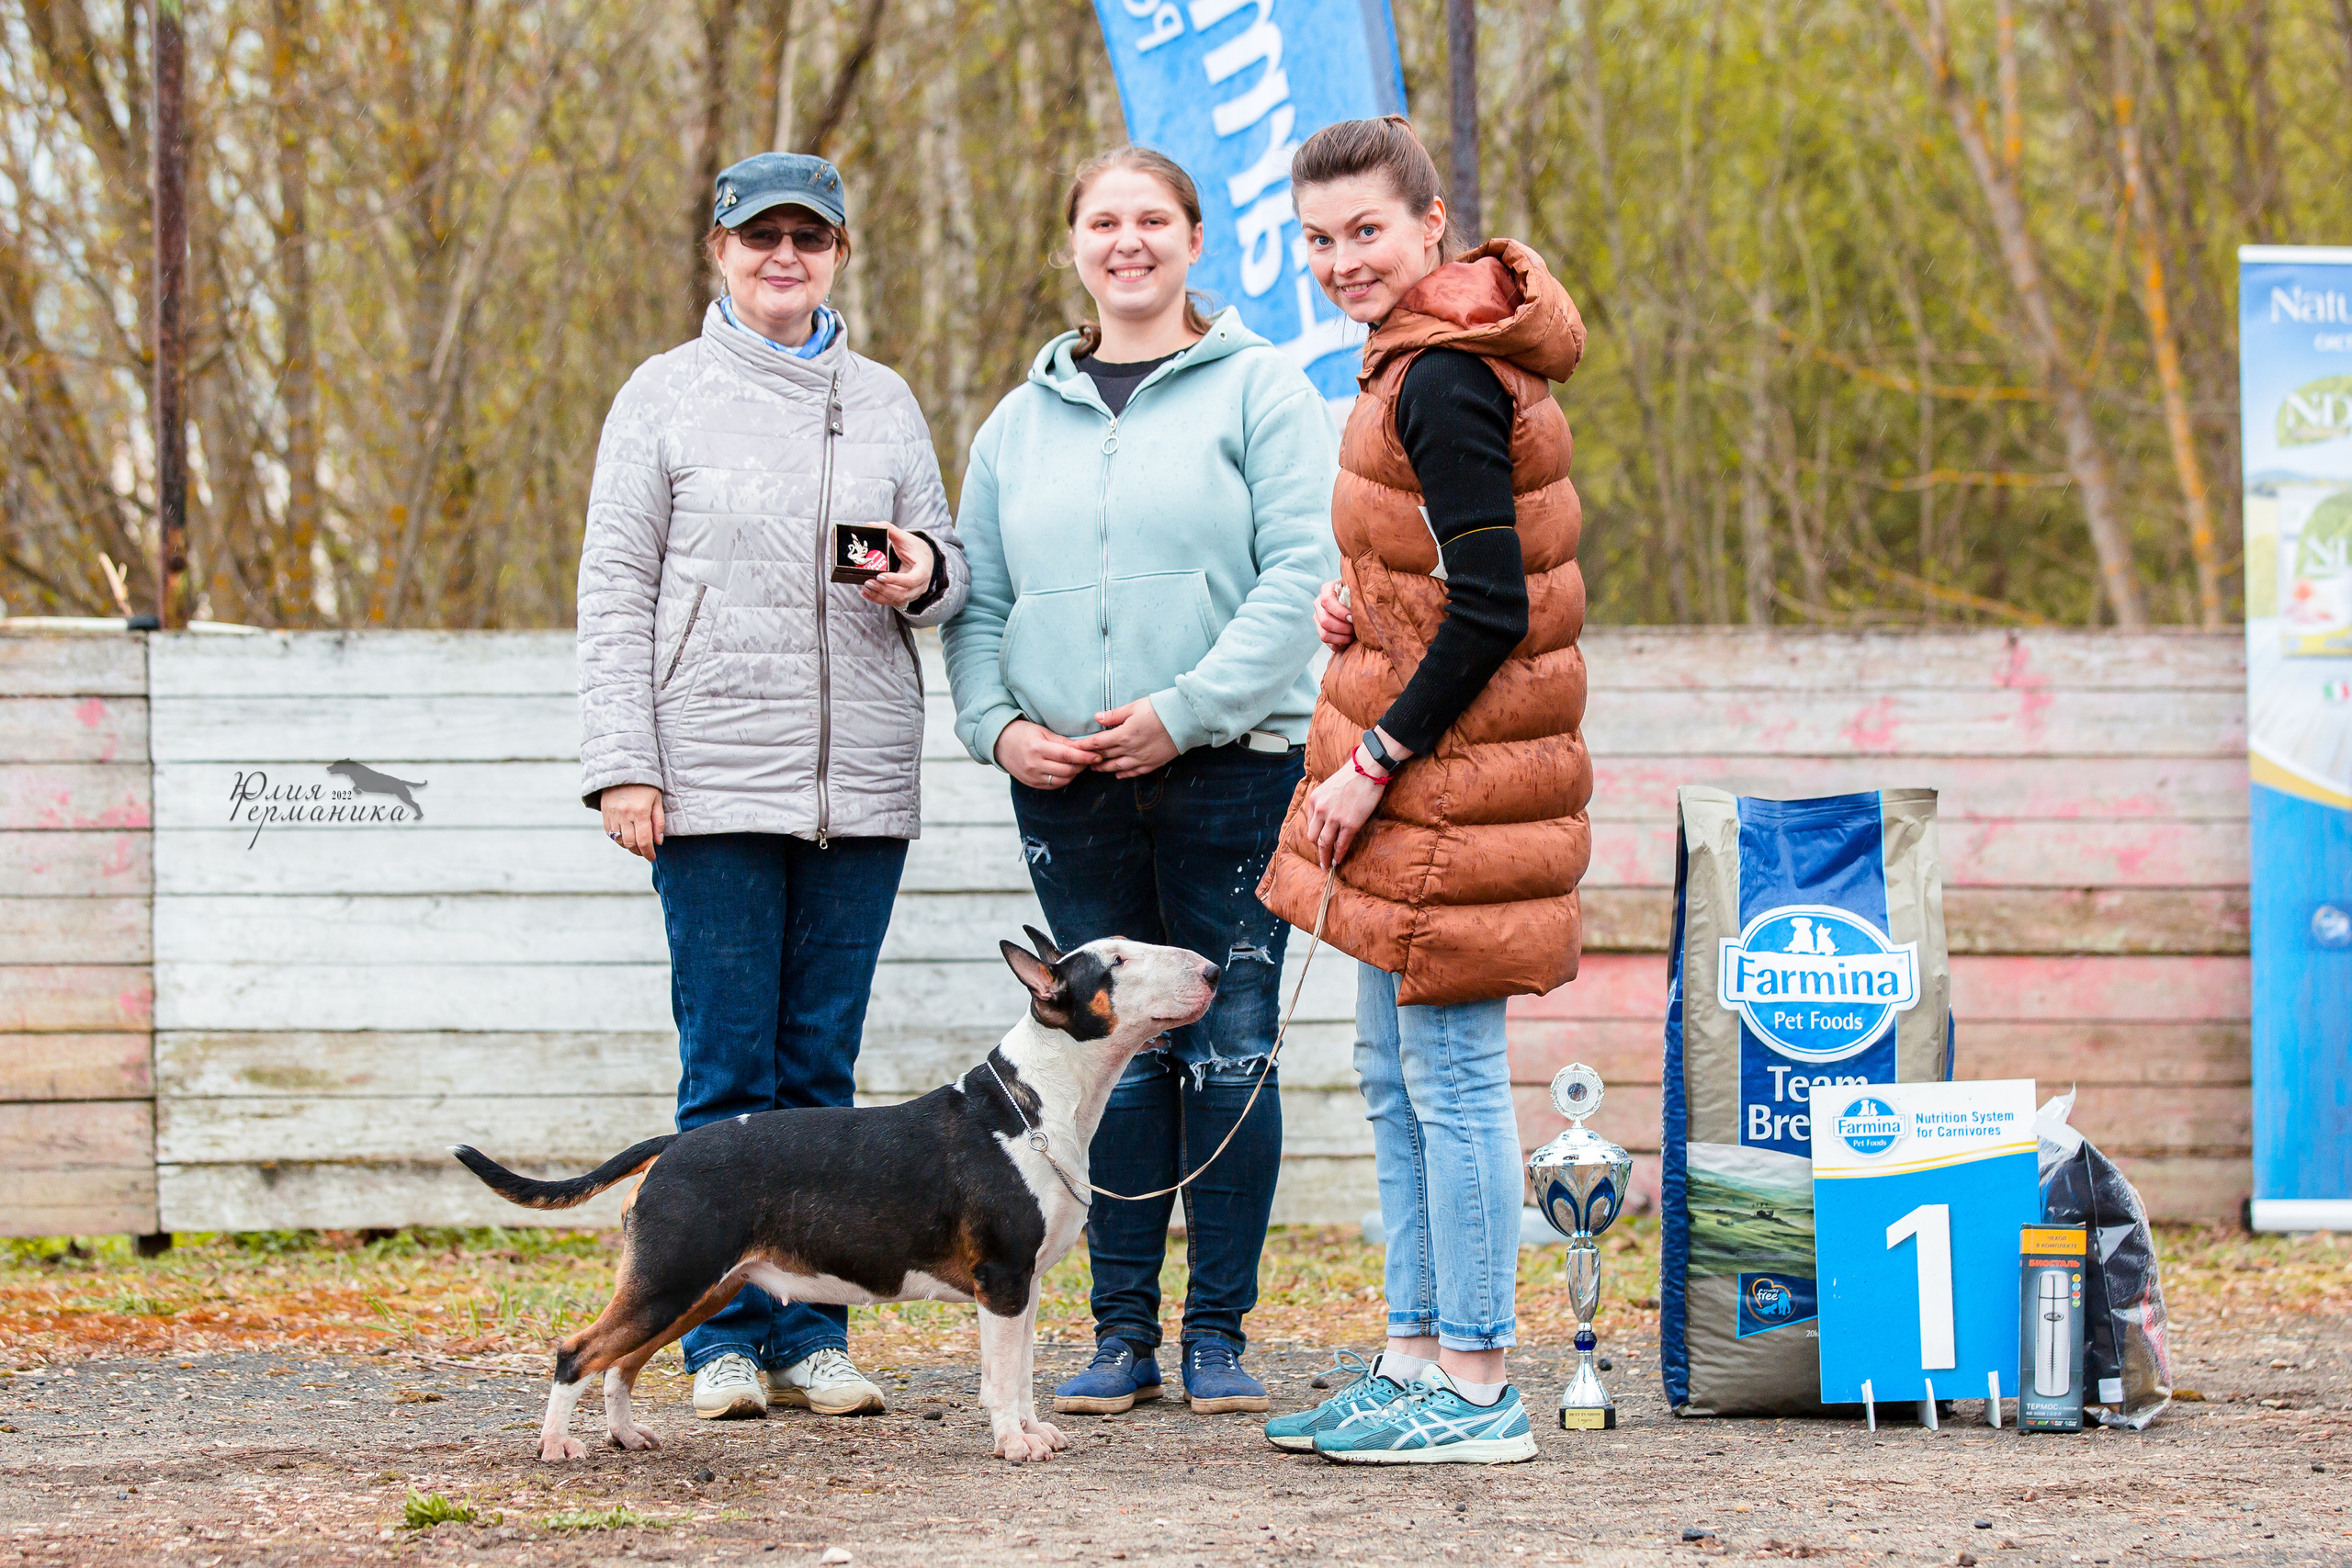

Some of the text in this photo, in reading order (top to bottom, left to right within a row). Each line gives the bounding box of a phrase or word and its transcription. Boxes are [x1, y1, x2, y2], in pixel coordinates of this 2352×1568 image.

[1736, 955, 1898, 996] Farmina
[1774, 1011, 1863, 1030] Pet Foods
[1747, 1104, 1811, 1140] Bre
[1916, 1111, 2014, 1124] Nutrition System
[1838, 1119, 1901, 1134] Farmina
[1917, 1125, 2001, 1138] for Carnivores
[1853, 1138, 1887, 1147] Pet Foods
[2029, 1259, 2081, 1268] БИОСТАЛЬ
[1886, 1203, 1956, 1370] 1
[1757, 1288, 1779, 1301] free
[1806, 1329, 1819, 1337] 20k
